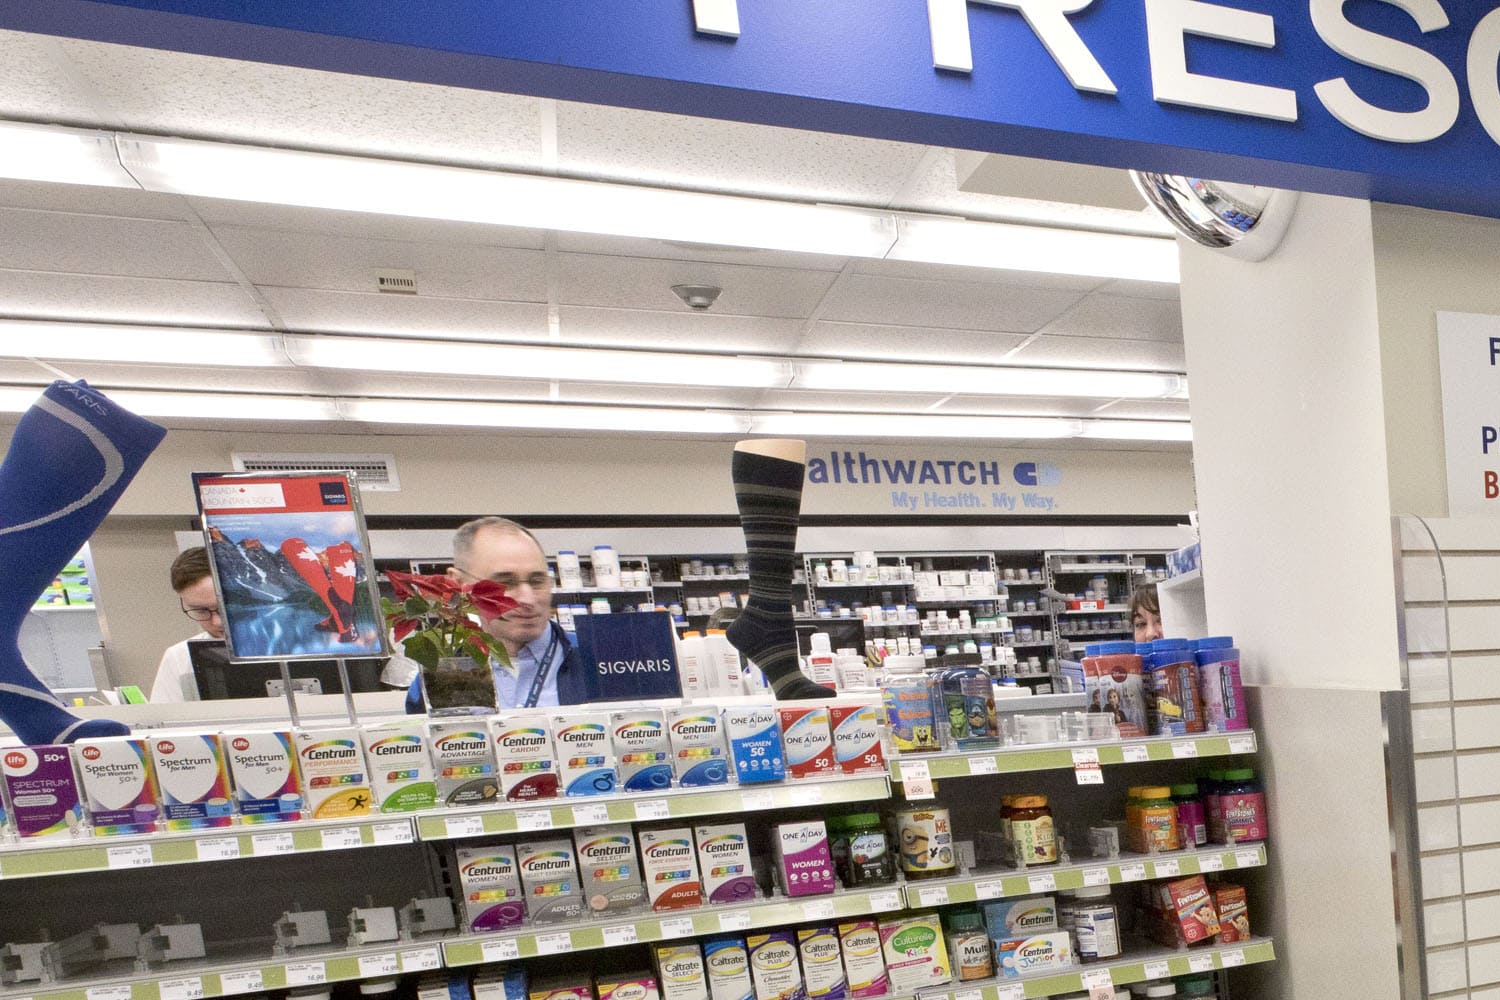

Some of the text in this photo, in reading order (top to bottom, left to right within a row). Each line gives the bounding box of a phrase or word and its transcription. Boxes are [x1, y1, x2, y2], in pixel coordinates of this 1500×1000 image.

[808, 451, 1000, 486] althWATCH
[892, 491, 1059, 511] My Health. My Way.
[598, 658, 671, 675] SIGVARIS
[731, 717, 749, 725] ONE
[757, 715, 774, 724] DAY
[621, 728, 662, 739] Centrum
[677, 723, 717, 735] Centrum
[502, 735, 546, 747] Centrum
[563, 731, 605, 743] Centrum
[787, 737, 804, 745] ONE
[810, 735, 827, 744] DAY
[837, 733, 855, 741] ONE
[861, 731, 876, 740] DAY
[441, 740, 486, 752] Centrum
[742, 740, 771, 748] WOMEN
[308, 748, 356, 760] Centrum
[376, 744, 422, 756] Centrum
[440, 750, 486, 759] ADVANTAGE
[510, 746, 540, 754] CARDIO
[750, 747, 765, 757] 50
[44, 754, 65, 762] 50+
[159, 757, 211, 770] Spectrum
[234, 754, 285, 767] Spectrum
[304, 758, 358, 768] PERFORMANCE
[815, 759, 829, 768] 50
[864, 754, 878, 764] 50
[85, 763, 138, 776] Spectrum
[12, 779, 70, 789] SPECTRUM
[808, 830, 823, 838] DAY
[587, 845, 631, 856] Centrum
[651, 846, 690, 857] Centrum
[705, 842, 744, 853] Centrum
[596, 854, 623, 862] SELECT
[528, 860, 570, 871] Centrum
[792, 860, 825, 869] WOMEN
[469, 865, 511, 876] Centrum
[468, 875, 498, 883] WOMEN
[671, 890, 699, 899] ADULTS
[551, 905, 580, 913] ADULTS
[1020, 914, 1054, 926] Centrum
[845, 936, 877, 948] Caltrate
[893, 929, 934, 946] Culturelle
[805, 942, 837, 953] Caltrate
[905, 947, 929, 956] Kids
[1023, 945, 1053, 955] Centrum
[711, 956, 744, 967] Caltrate
[758, 950, 790, 962] Caltrate
[665, 961, 699, 973] Caltrate
[672, 969, 694, 977] SELECT
[617, 989, 642, 997] Caltrate
